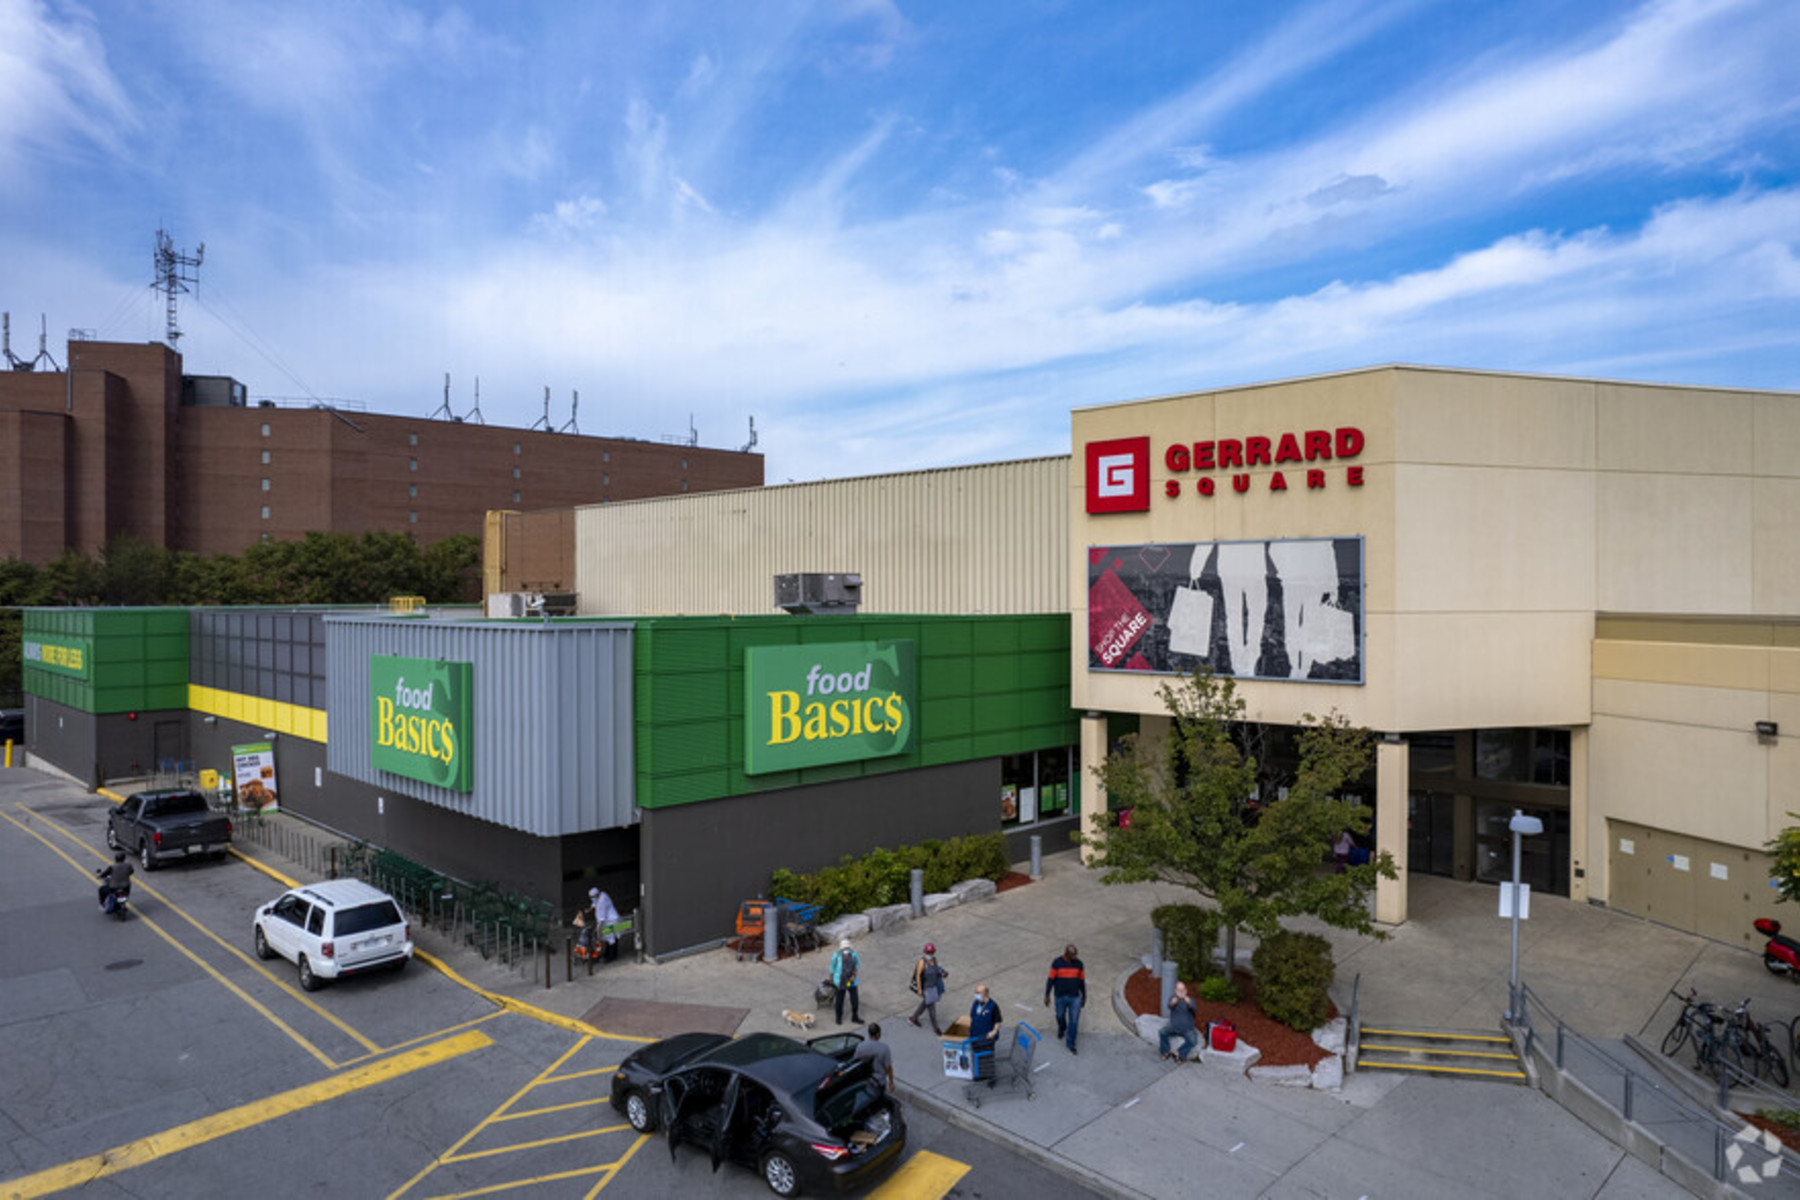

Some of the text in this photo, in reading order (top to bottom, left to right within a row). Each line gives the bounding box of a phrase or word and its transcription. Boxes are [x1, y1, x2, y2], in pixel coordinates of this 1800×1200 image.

[1164, 427, 1365, 473] GERRARD
[1164, 466, 1364, 498] SQUARE
[1102, 611, 1147, 665] SQUARE
[395, 677, 433, 711] food
[806, 663, 872, 696] food
